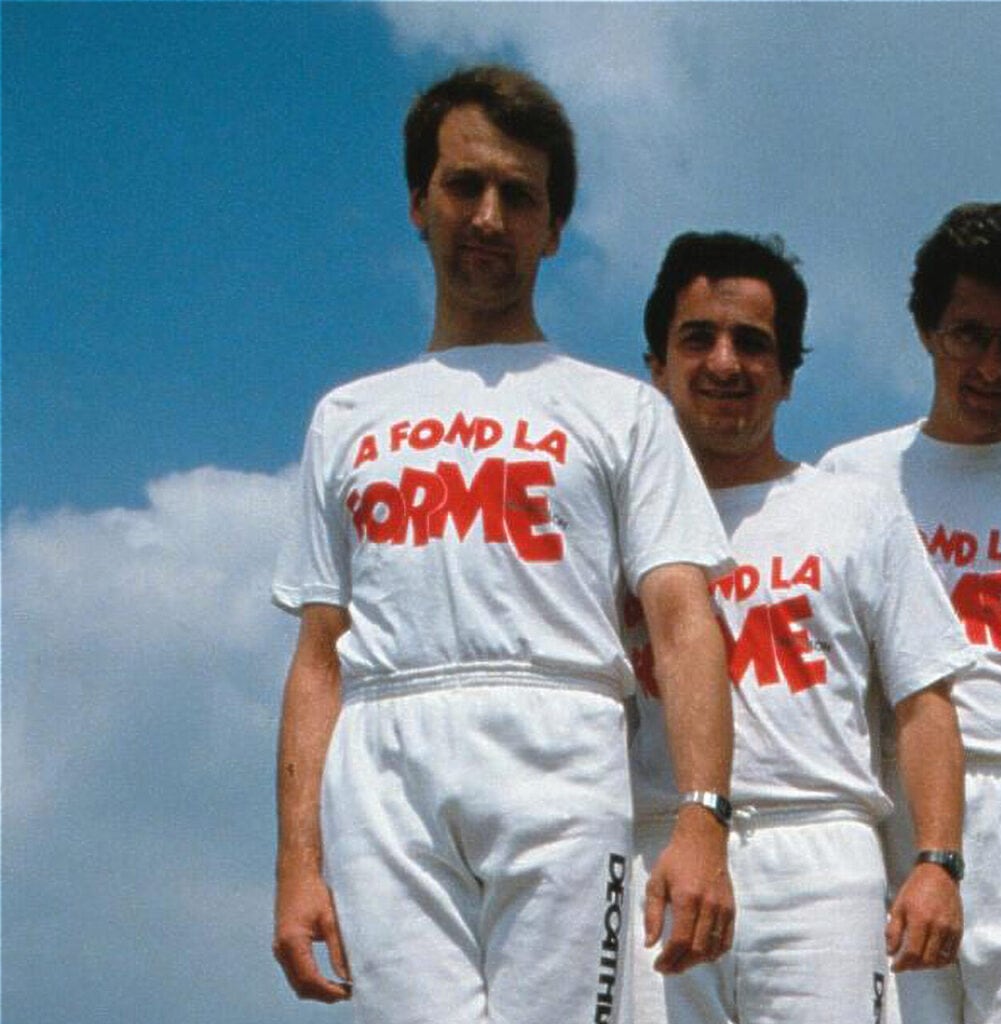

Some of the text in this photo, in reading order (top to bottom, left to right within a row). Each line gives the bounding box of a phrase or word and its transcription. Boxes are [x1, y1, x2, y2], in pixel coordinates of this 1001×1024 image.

[354, 411, 567, 469] A FOND LA
[918, 523, 979, 568] ND
[771, 554, 822, 592] LA
